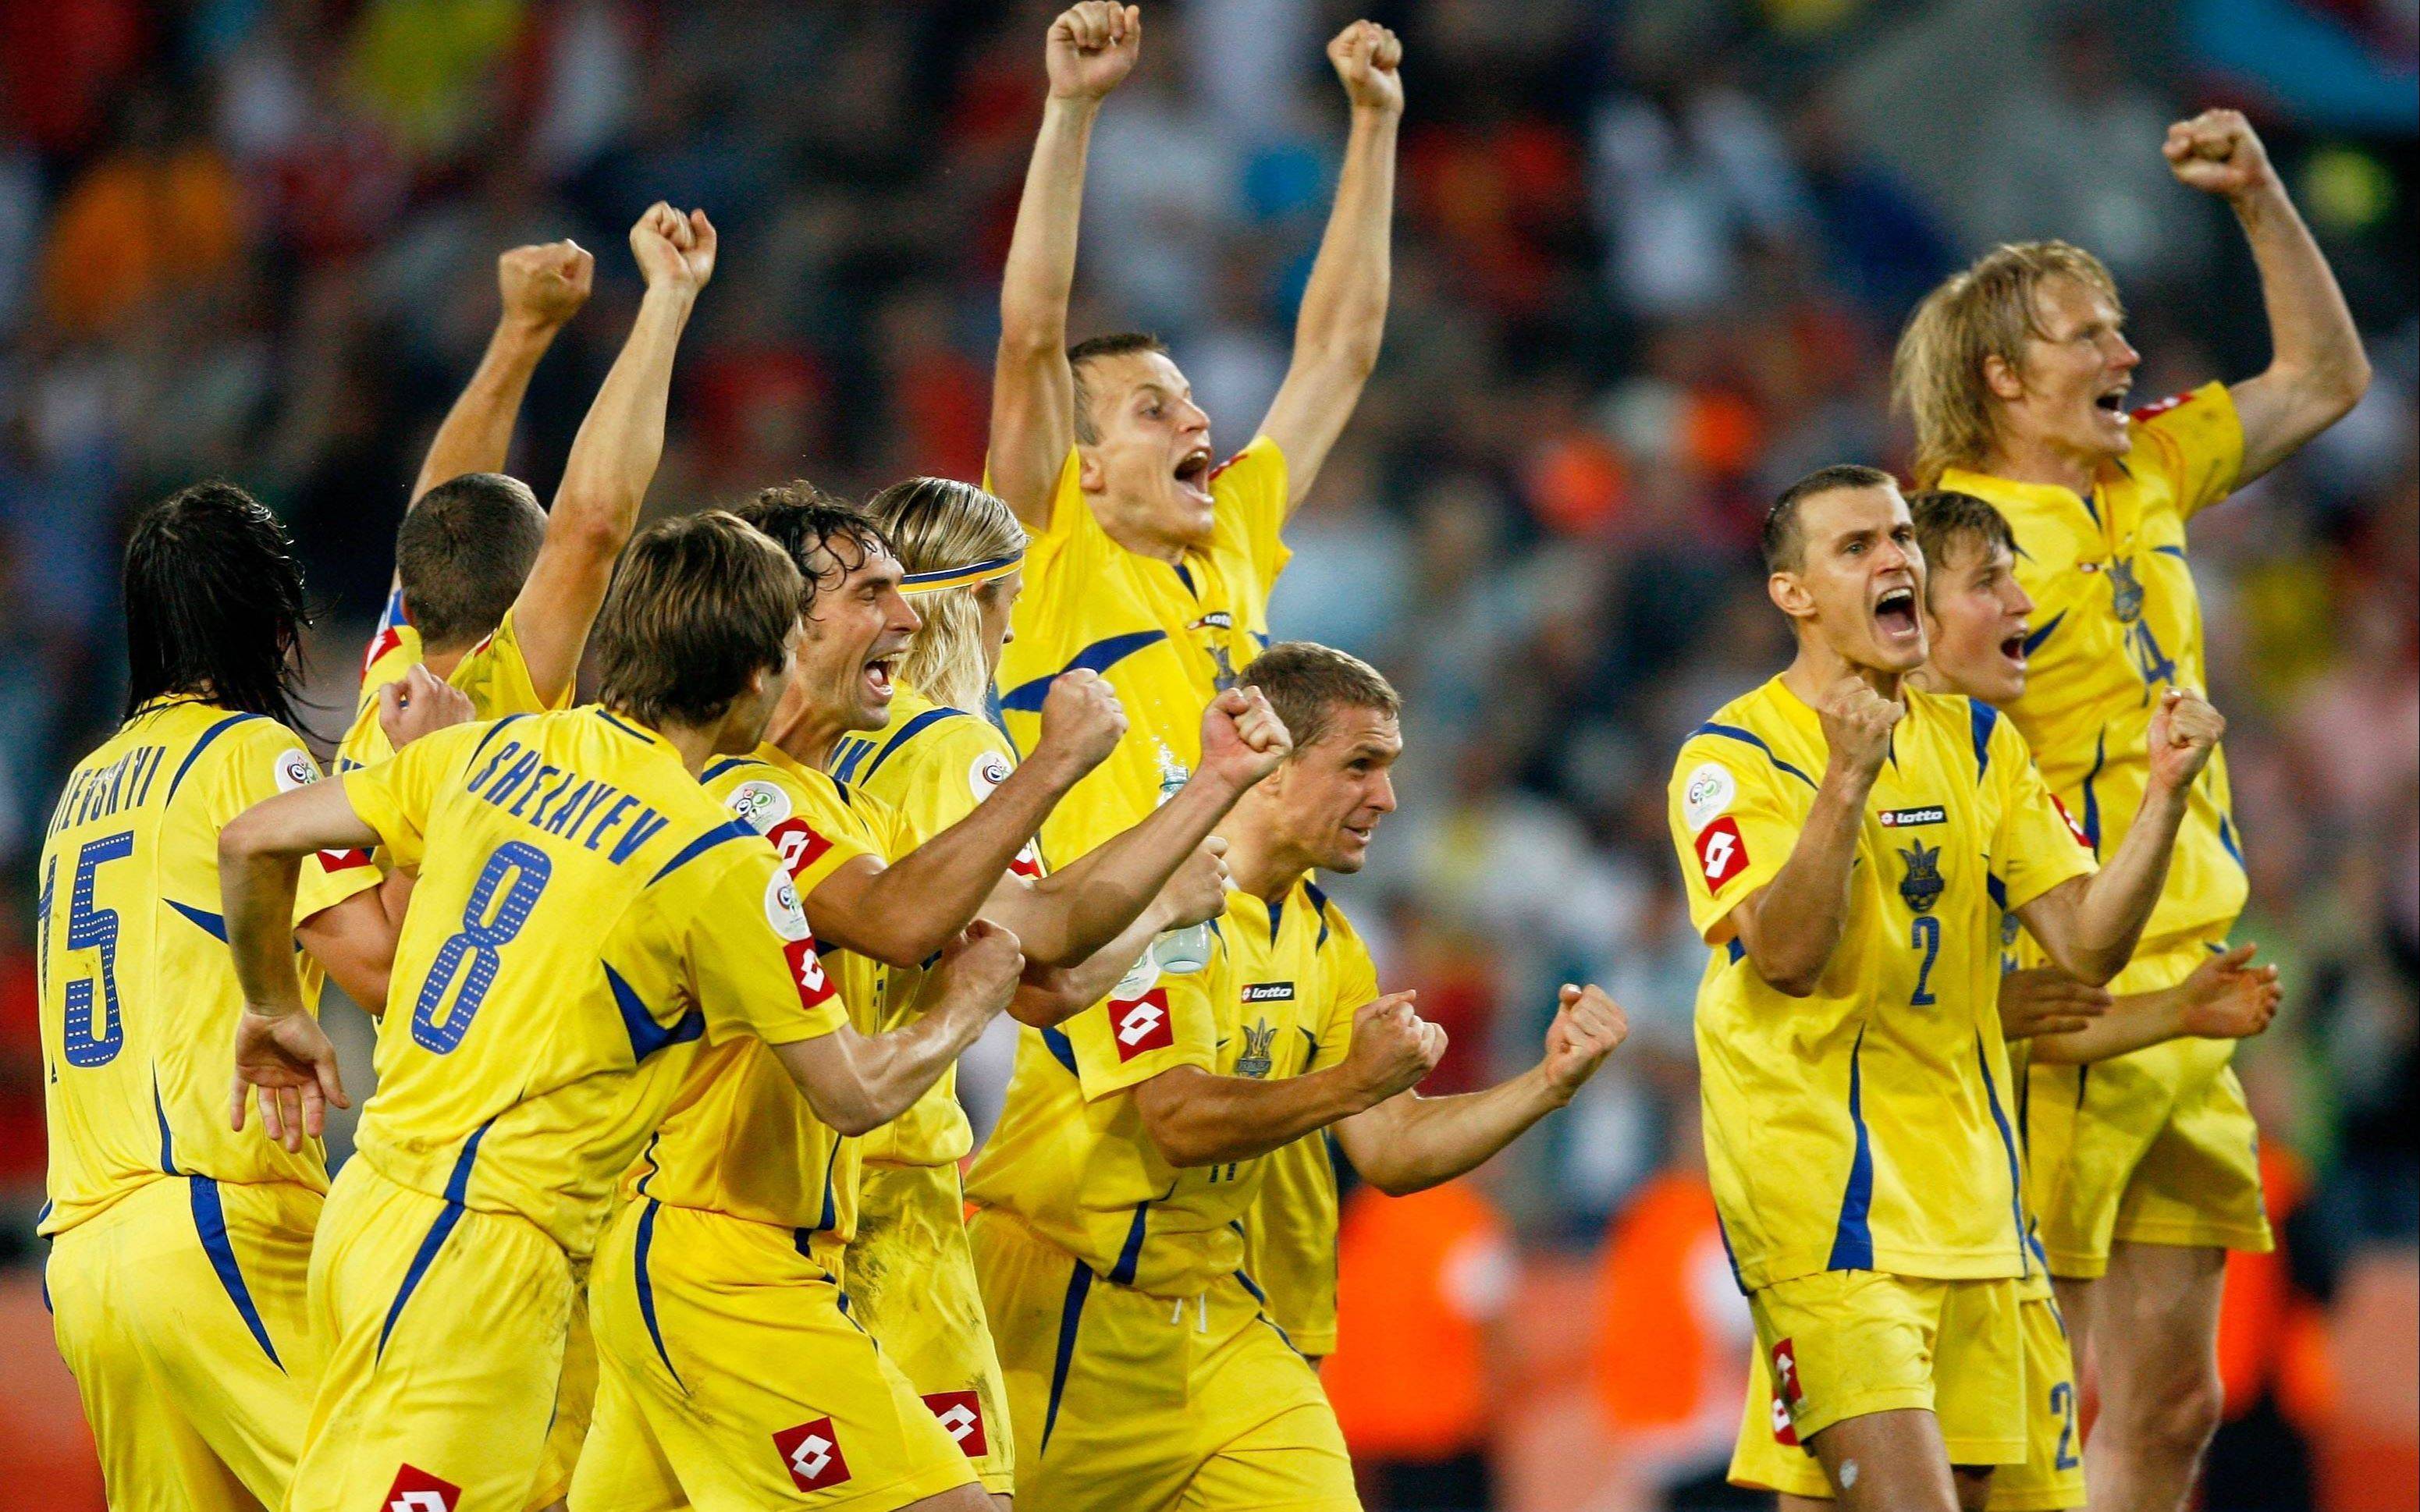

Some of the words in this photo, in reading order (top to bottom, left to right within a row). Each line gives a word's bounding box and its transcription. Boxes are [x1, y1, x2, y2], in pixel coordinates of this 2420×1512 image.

[467, 741, 670, 865] SHELAYEV
[1896, 811, 1944, 824] lotto
[37, 830, 133, 1083] 15
[411, 840, 552, 1055] 8
[1251, 986, 1292, 999] lotto
[1910, 916, 1940, 1006] 2
[2050, 1382, 2079, 1471] 2
